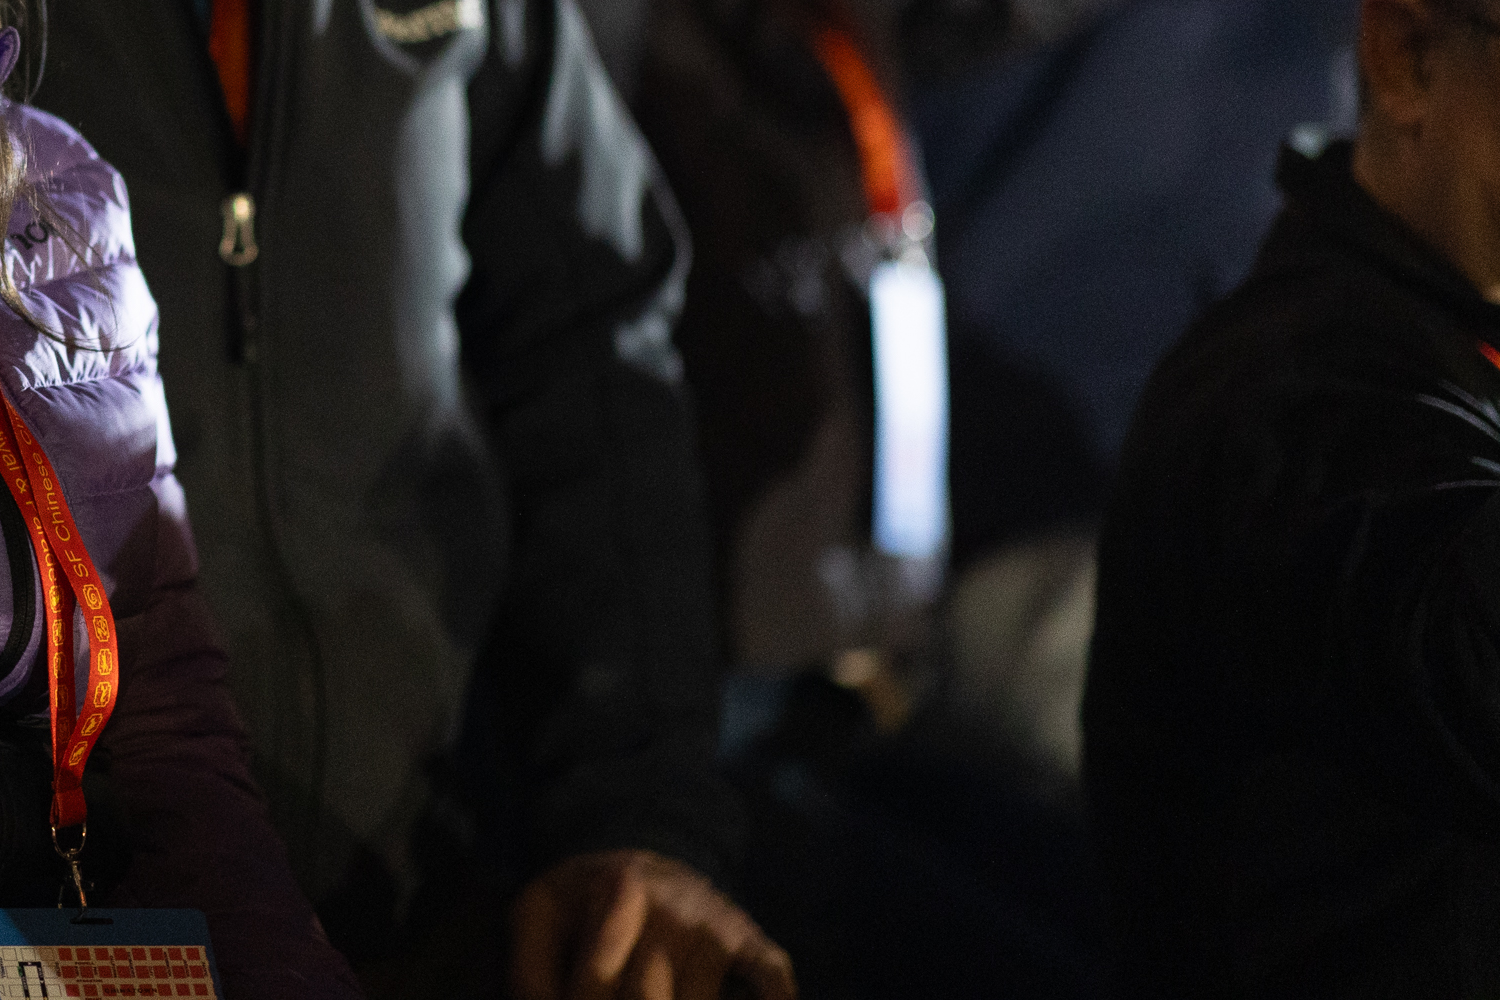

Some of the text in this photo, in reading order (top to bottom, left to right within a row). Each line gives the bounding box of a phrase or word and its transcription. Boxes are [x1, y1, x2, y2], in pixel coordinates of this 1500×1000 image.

[16, 478, 32, 494] &
[33, 452, 89, 578] SF Chinese
